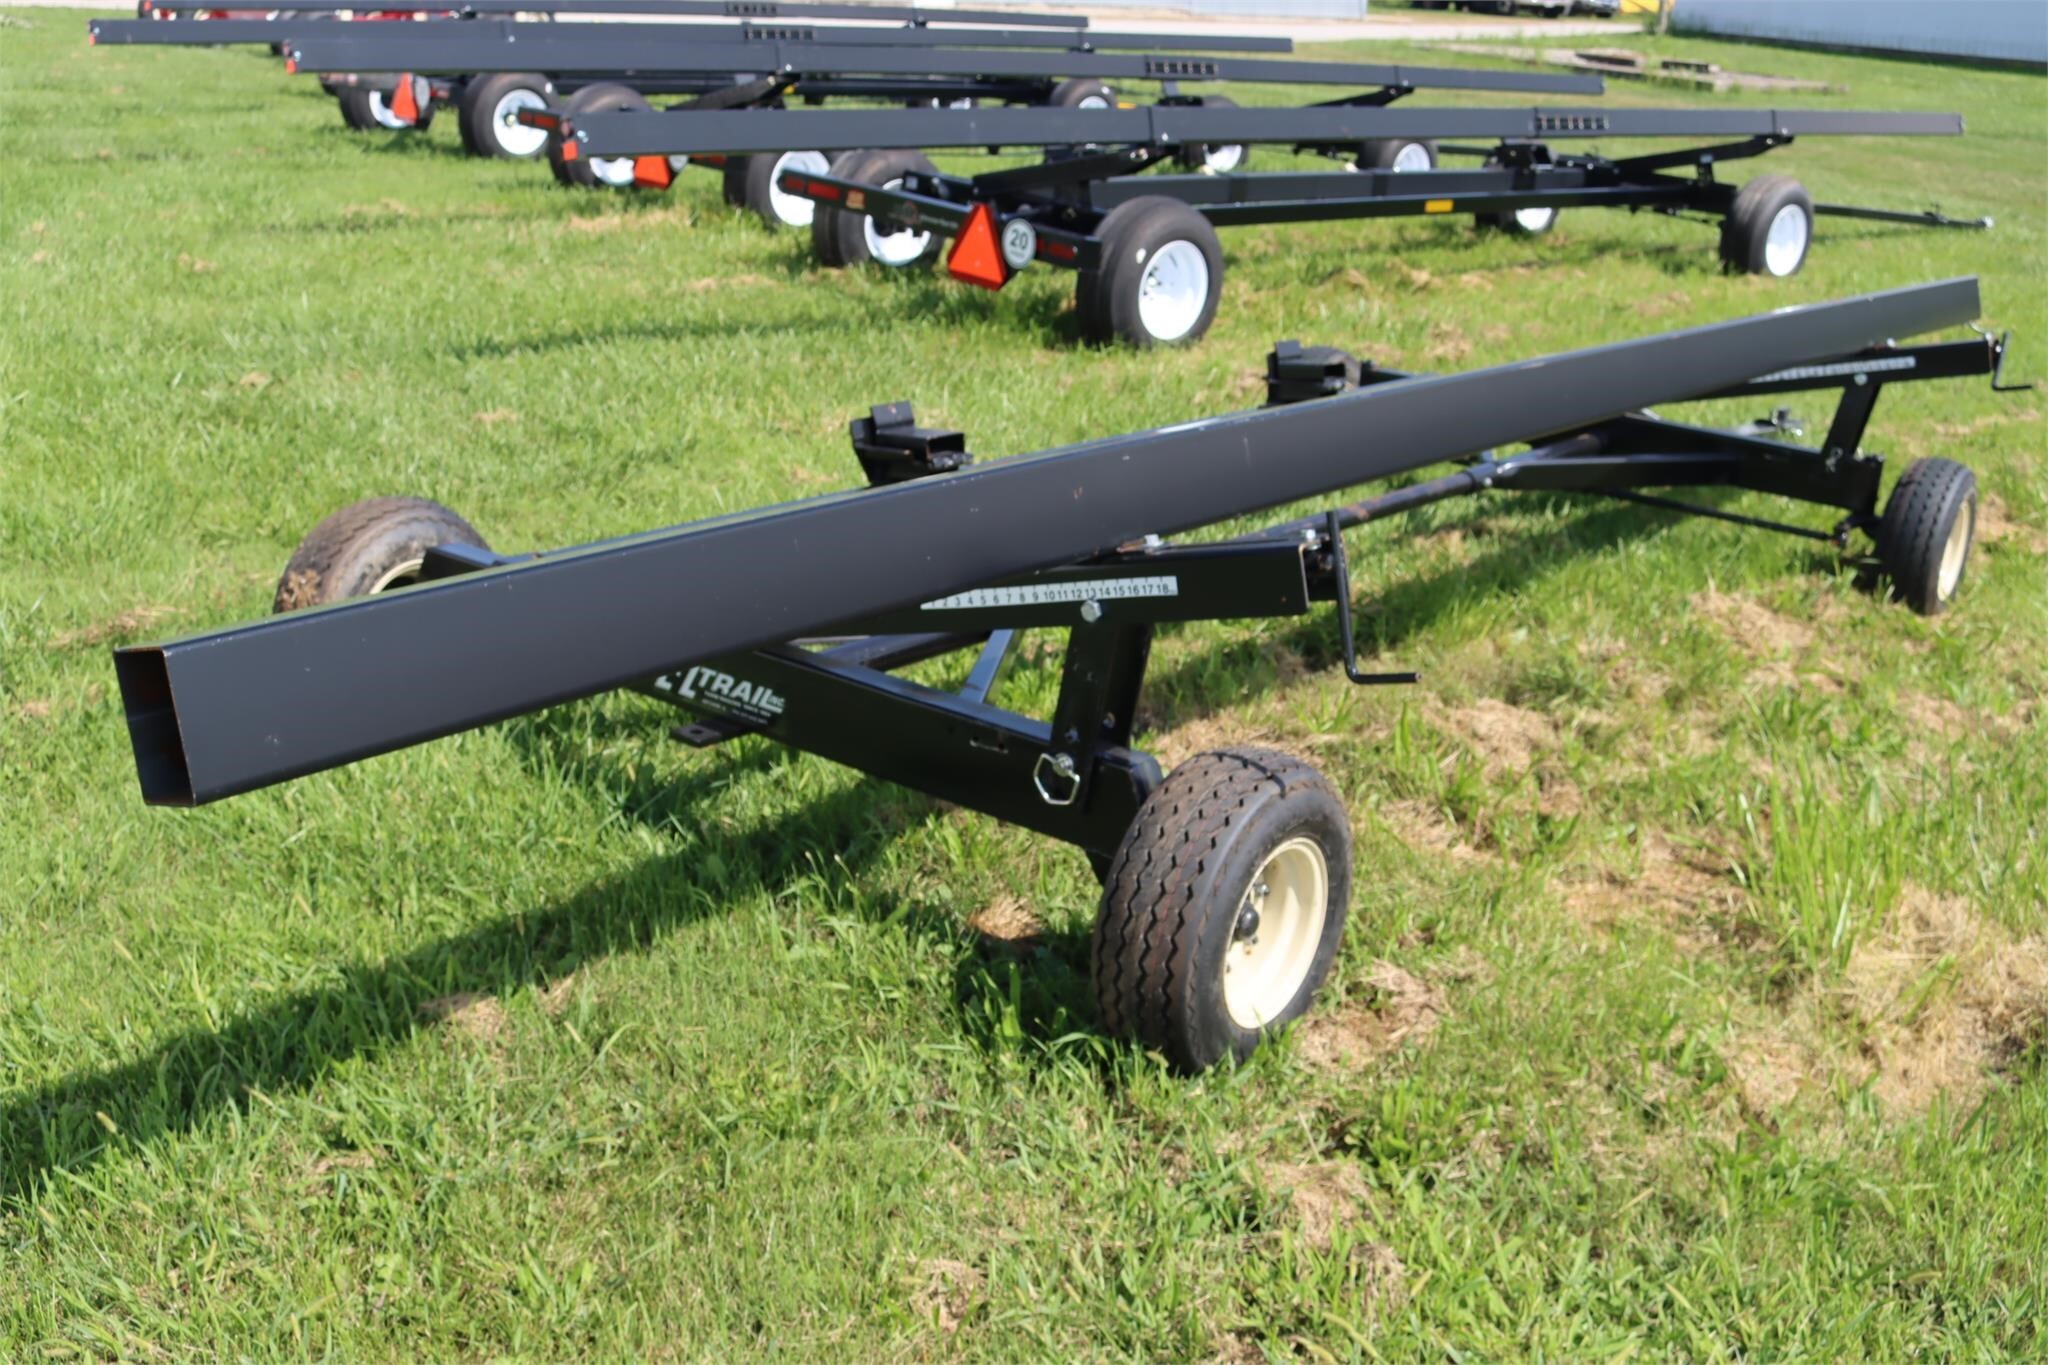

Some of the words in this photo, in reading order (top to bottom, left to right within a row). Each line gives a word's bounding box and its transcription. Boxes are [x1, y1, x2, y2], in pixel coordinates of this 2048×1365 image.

[1010, 229, 1029, 250] 20
[955, 596, 961, 606] 3
[967, 595, 974, 605] 4
[980, 595, 986, 605] 5
[993, 594, 1000, 604] 6
[1006, 593, 1012, 603] 7
[1019, 592, 1026, 603] 8
[1032, 591, 1039, 602] 9
[1043, 590, 1056, 601] 10
[1057, 589, 1068, 600] 11
[1071, 589, 1082, 599] 12
[1085, 587, 1097, 599] 13
[1099, 587, 1111, 597] 14
[1113, 586, 1126, 596] 15
[1128, 584, 1140, 595] 16
[1141, 583, 1154, 594] 17
[1156, 583, 1169, 594] 18
[698, 666, 783, 714] TRAIL
